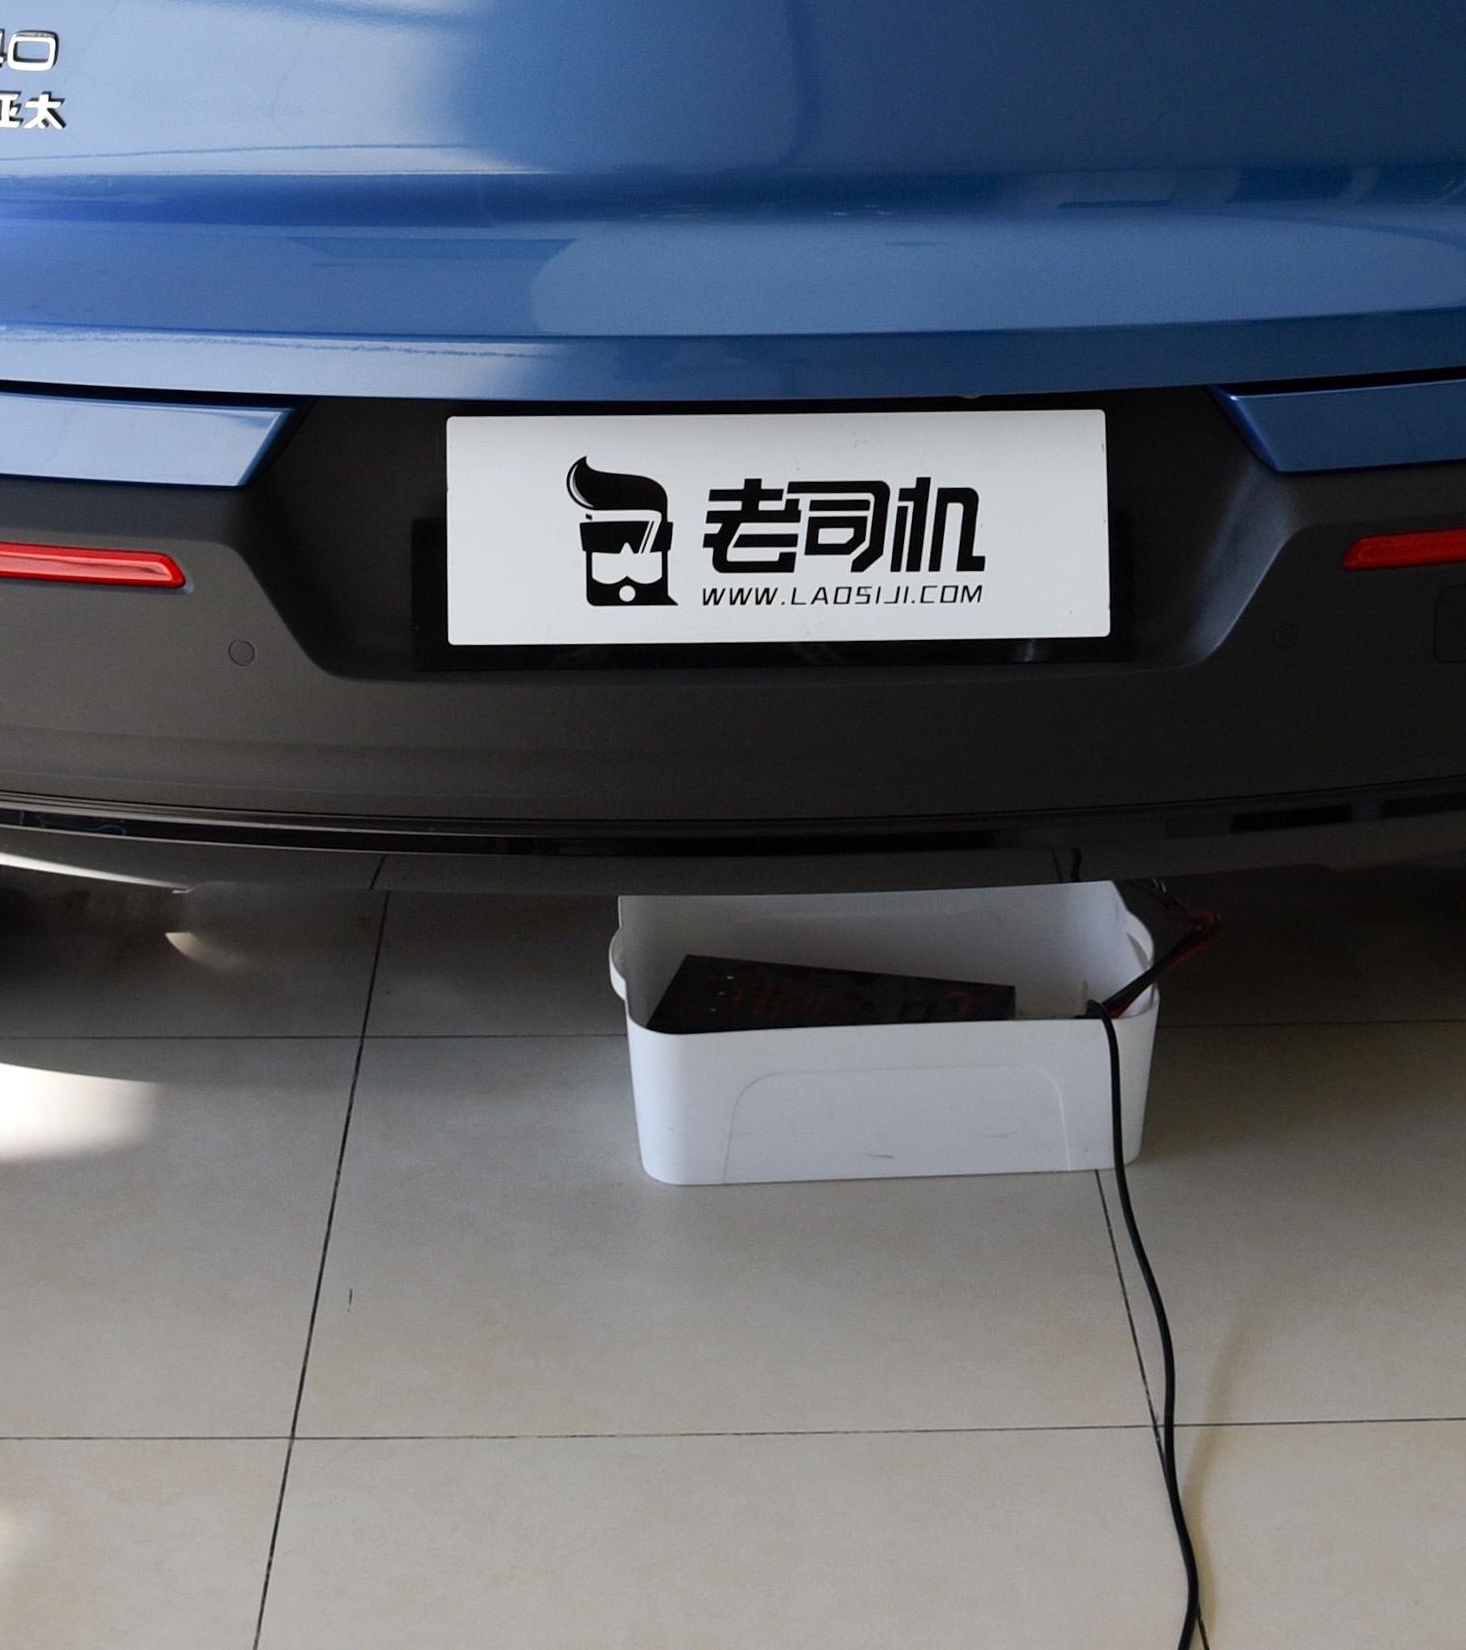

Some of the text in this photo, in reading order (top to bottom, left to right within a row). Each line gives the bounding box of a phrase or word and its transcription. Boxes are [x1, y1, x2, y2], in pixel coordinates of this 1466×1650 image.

[702, 476, 986, 573] 老司机
[702, 584, 983, 606] WWW.LAOSIJI.COM
